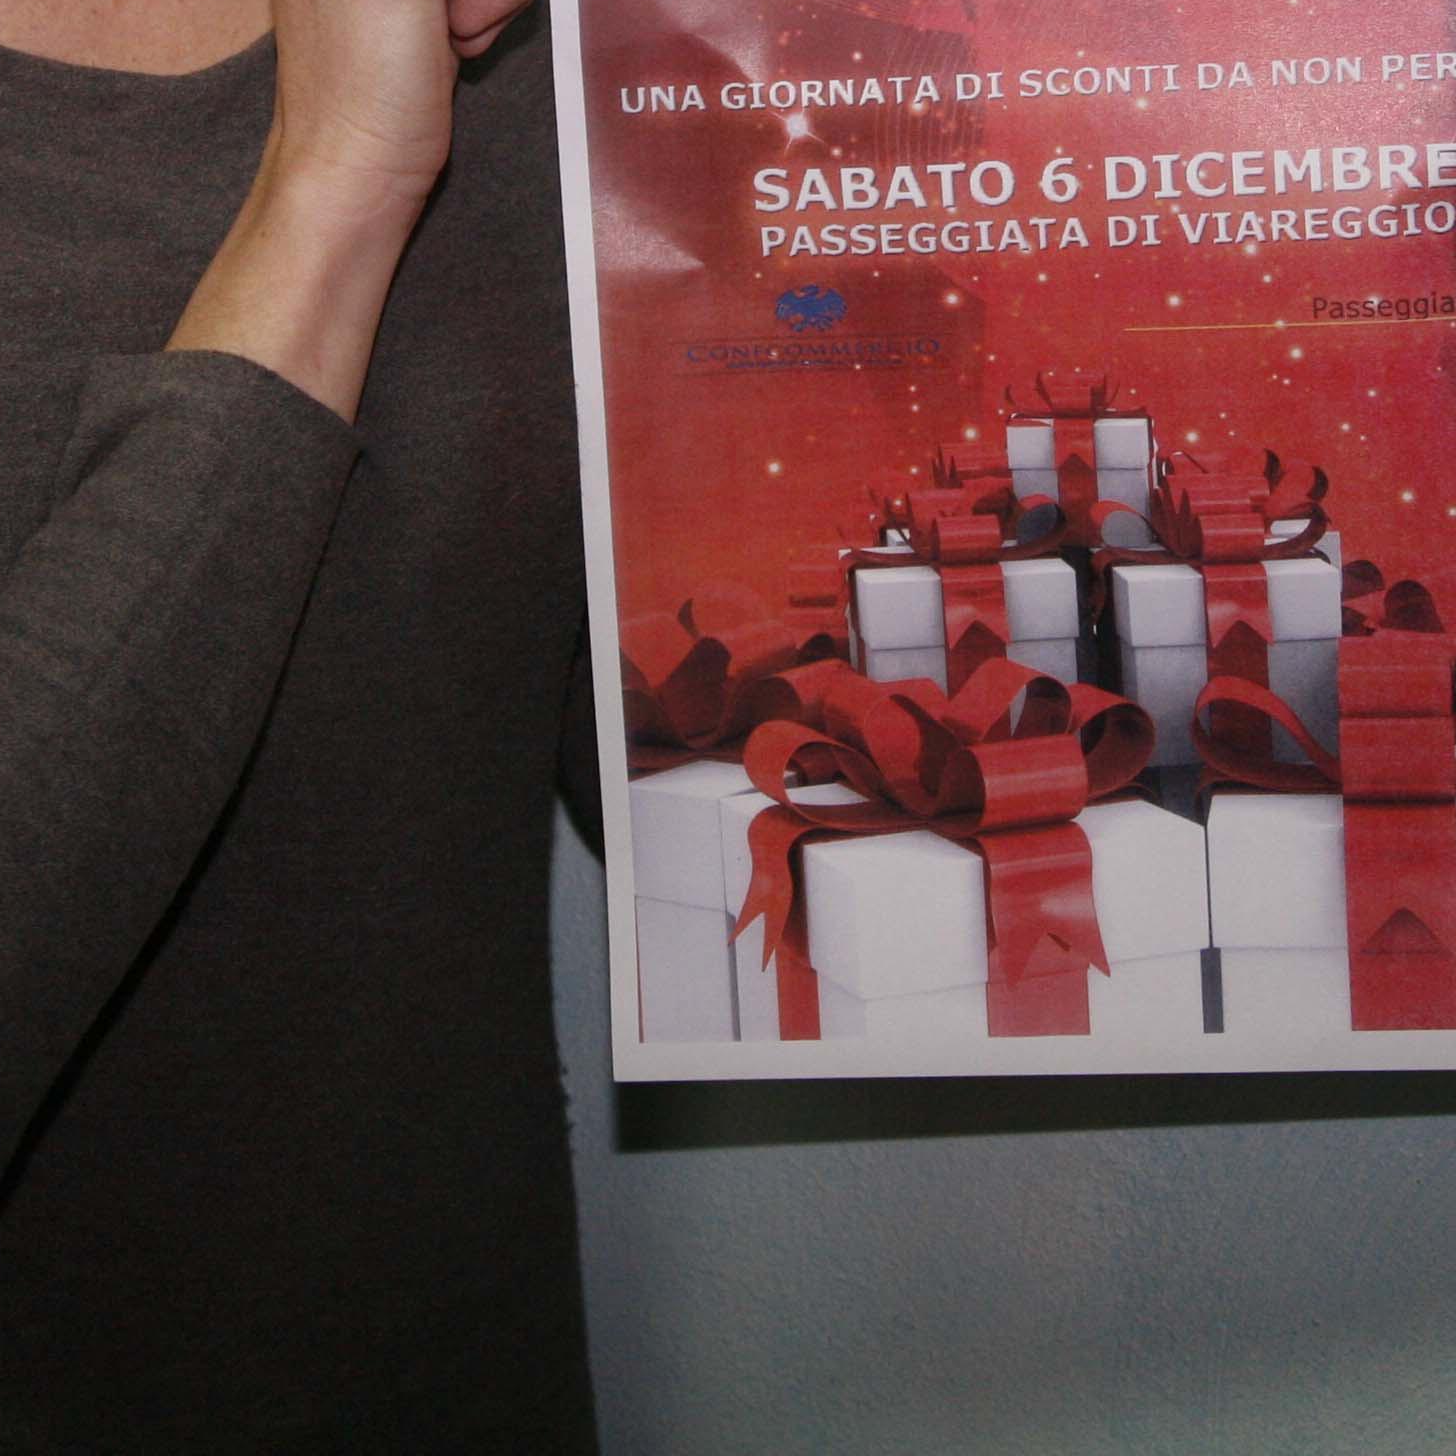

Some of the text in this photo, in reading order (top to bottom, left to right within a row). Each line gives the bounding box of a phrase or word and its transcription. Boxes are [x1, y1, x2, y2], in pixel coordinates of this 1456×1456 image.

[620, 84, 705, 114] UNA
[720, 74, 940, 110] GIORNATA
[955, 71, 1004, 102] DI
[1019, 64, 1179, 97] SCONTI
[1197, 60, 1253, 91] DA
[1271, 56, 1362, 87] NON
[753, 160, 1015, 212] SABATO
[1042, 157, 1079, 203] 6
[760, 200, 1456, 257] PASSEGGIATA DI VIAREGGIO
